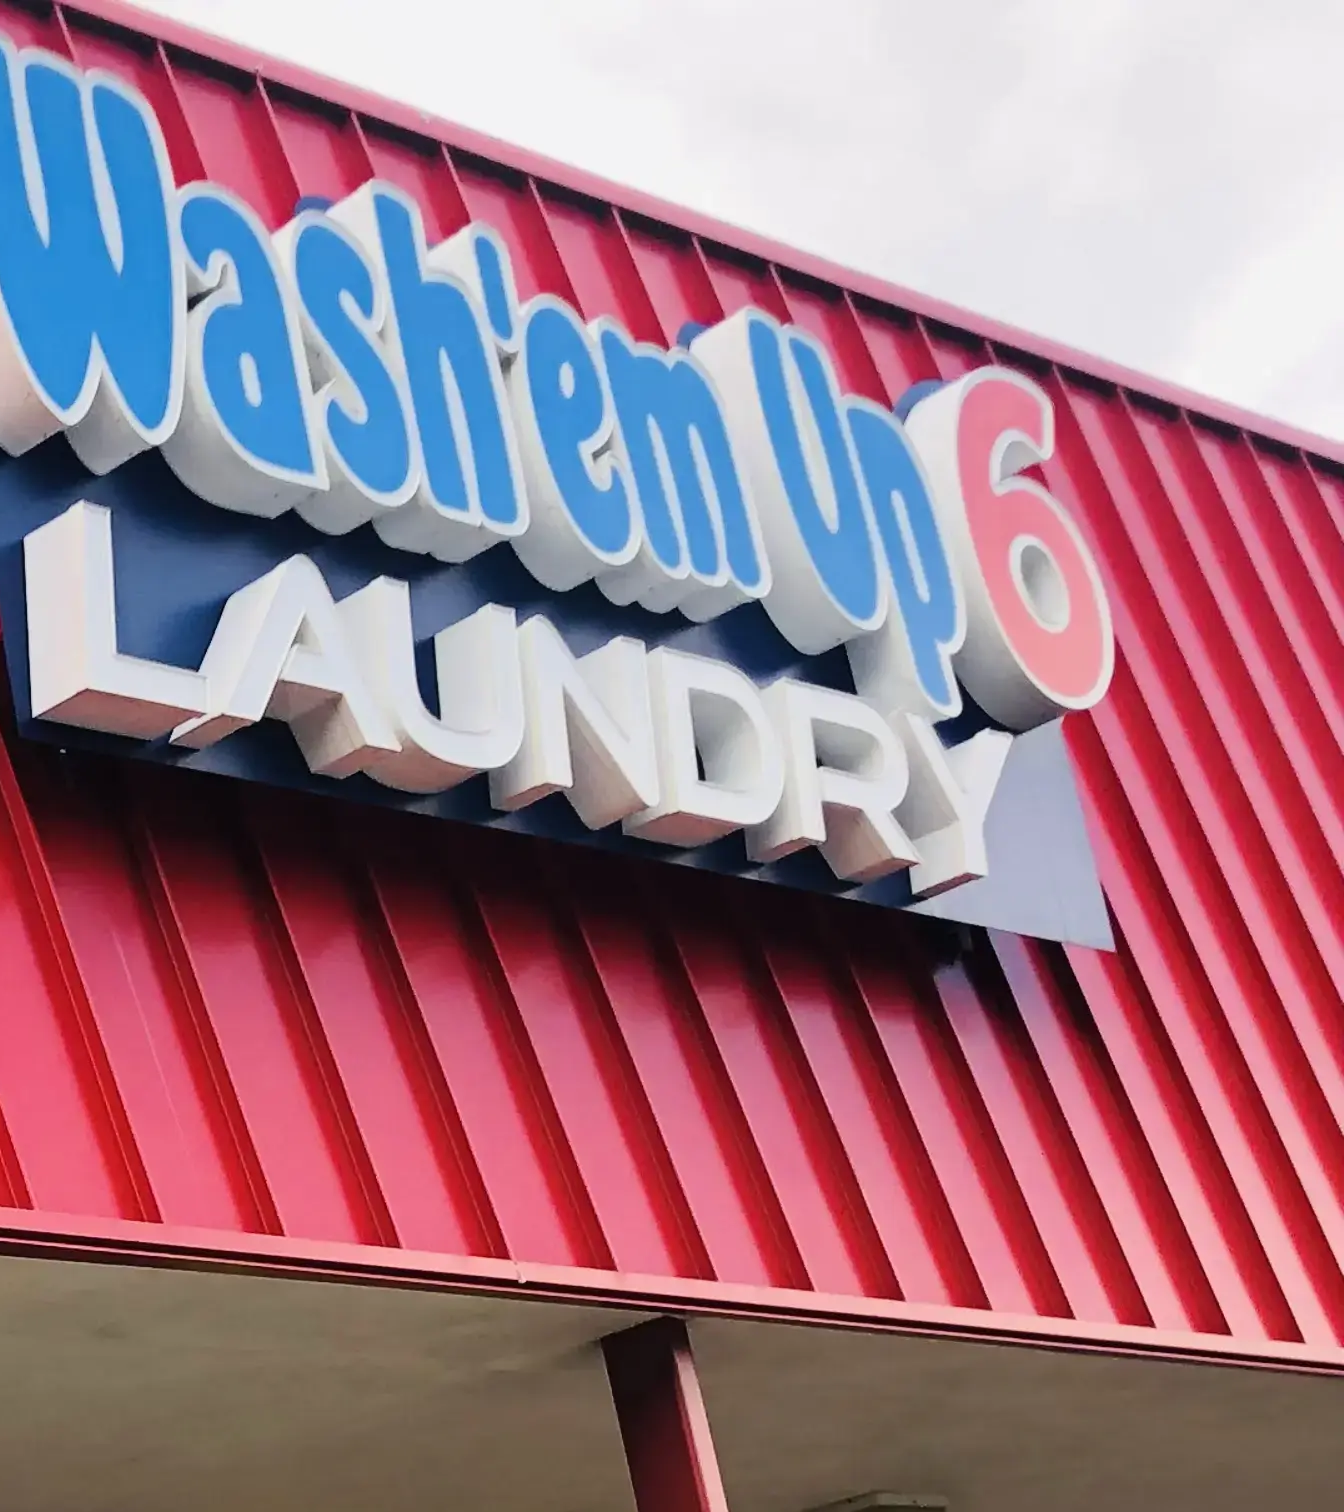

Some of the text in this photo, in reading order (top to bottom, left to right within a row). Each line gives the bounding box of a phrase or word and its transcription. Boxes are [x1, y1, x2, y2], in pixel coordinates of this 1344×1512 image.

[23, 500, 1013, 890] LAUNDRY
[737, 306, 966, 720] Up
[937, 366, 1116, 722] 6
